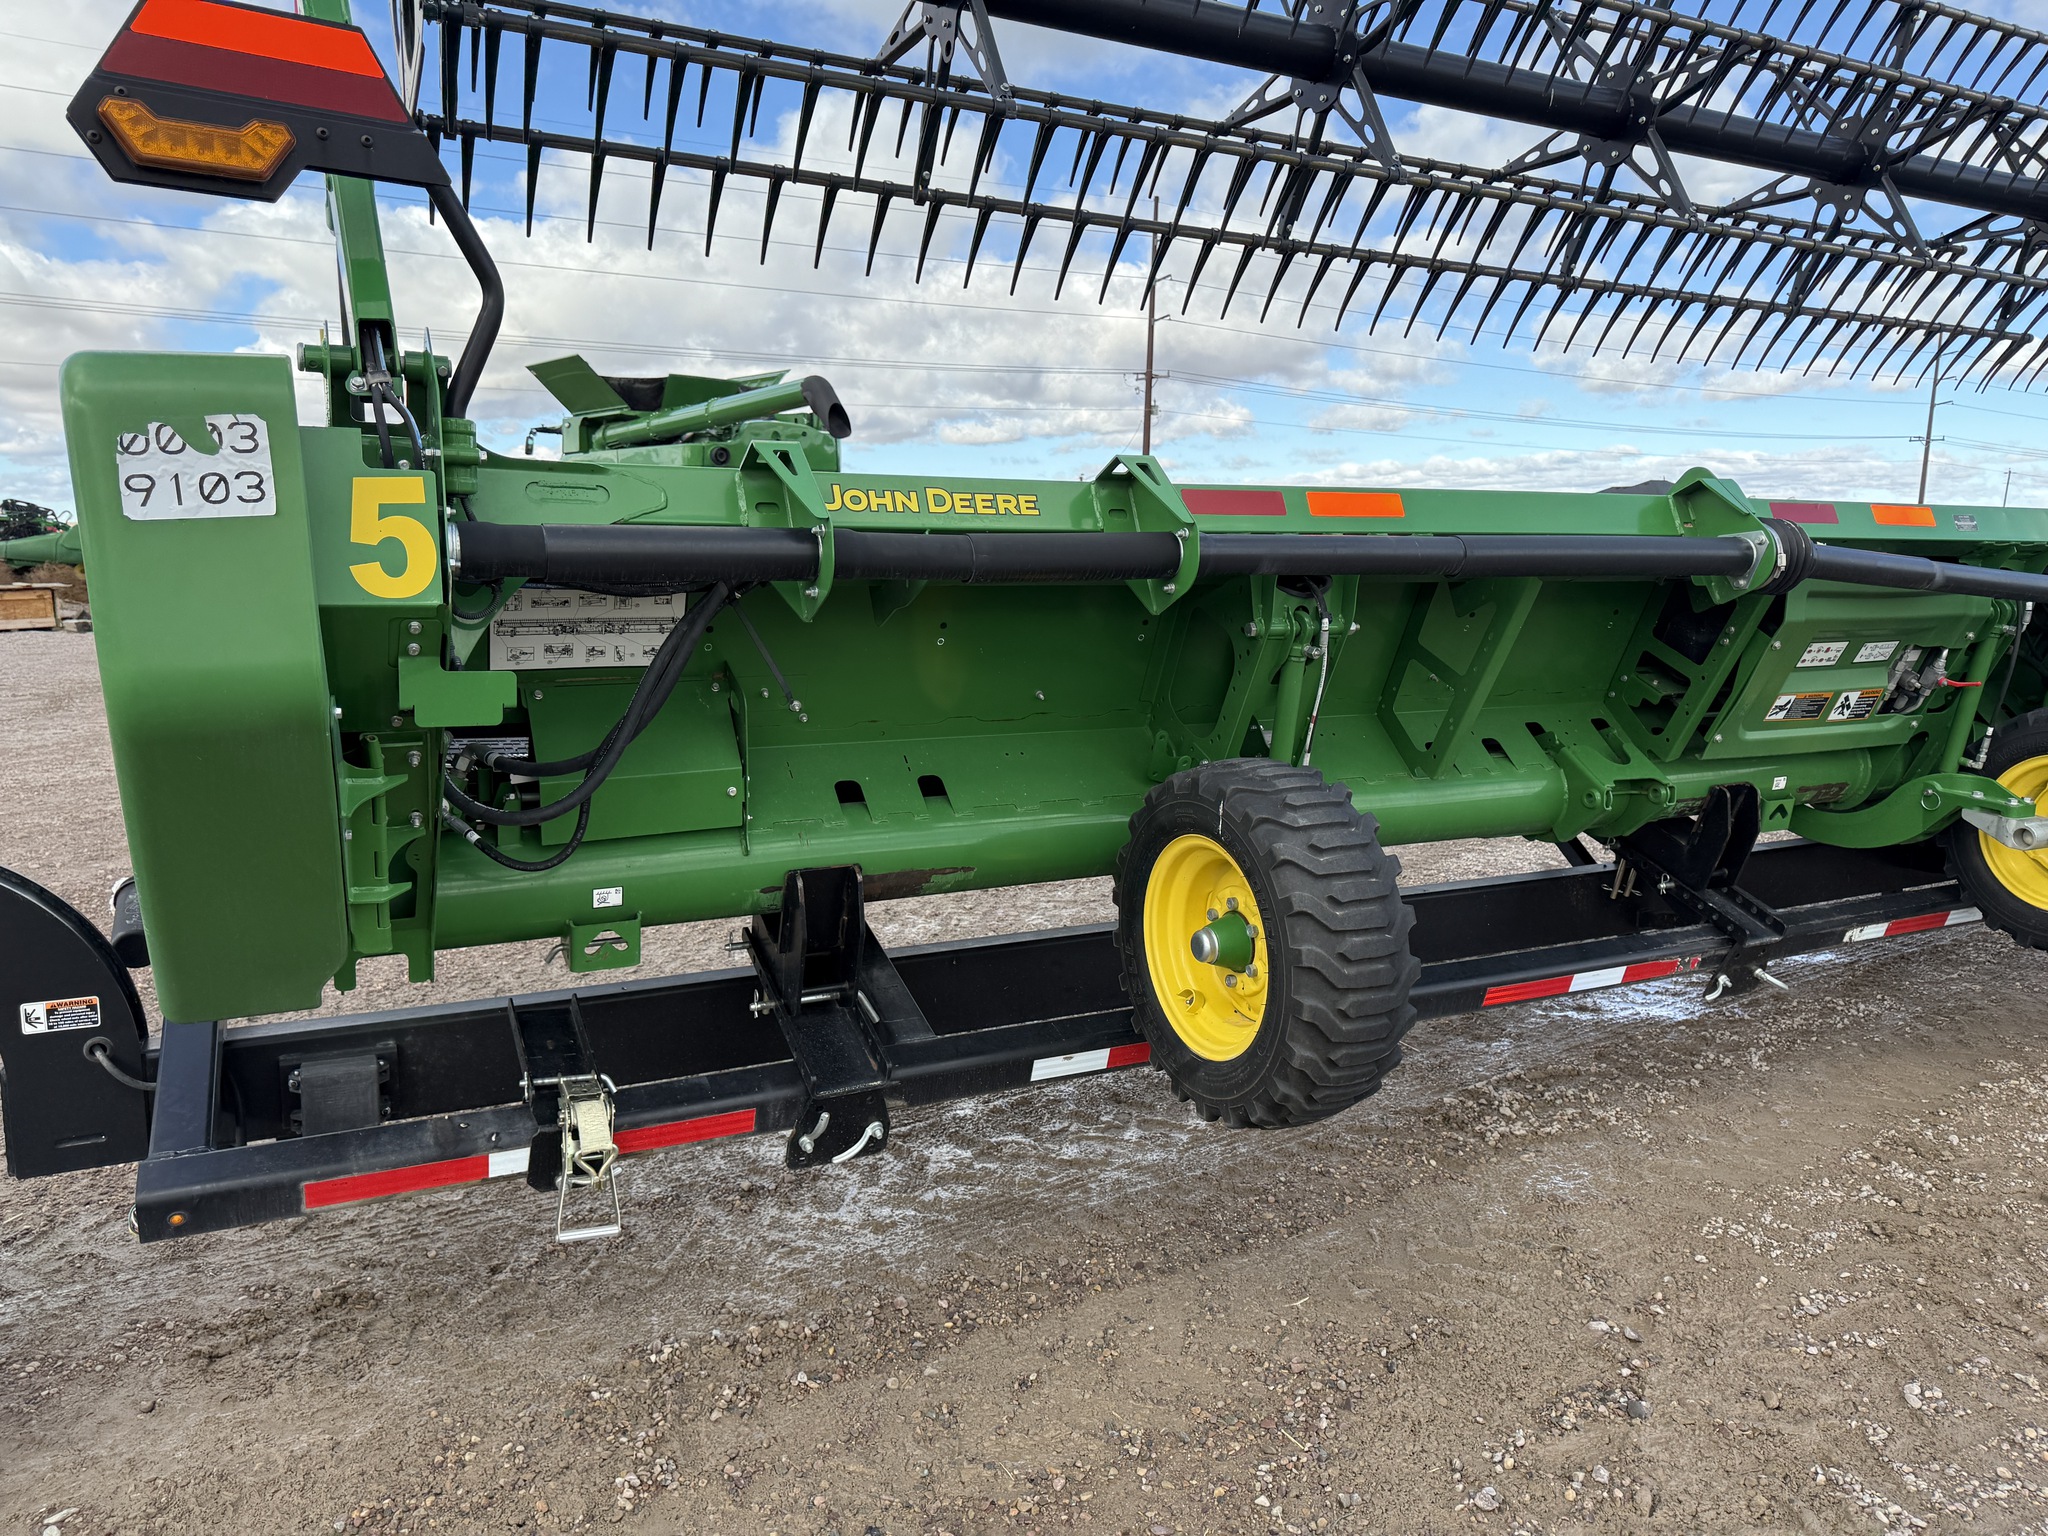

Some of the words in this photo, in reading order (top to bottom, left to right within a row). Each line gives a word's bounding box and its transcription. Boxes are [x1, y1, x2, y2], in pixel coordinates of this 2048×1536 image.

[124, 471, 266, 507] 9103
[825, 483, 920, 513] JOHN
[924, 487, 1041, 516] DEERE
[349, 476, 437, 599] 5
[57, 998, 94, 1007] WARNING
